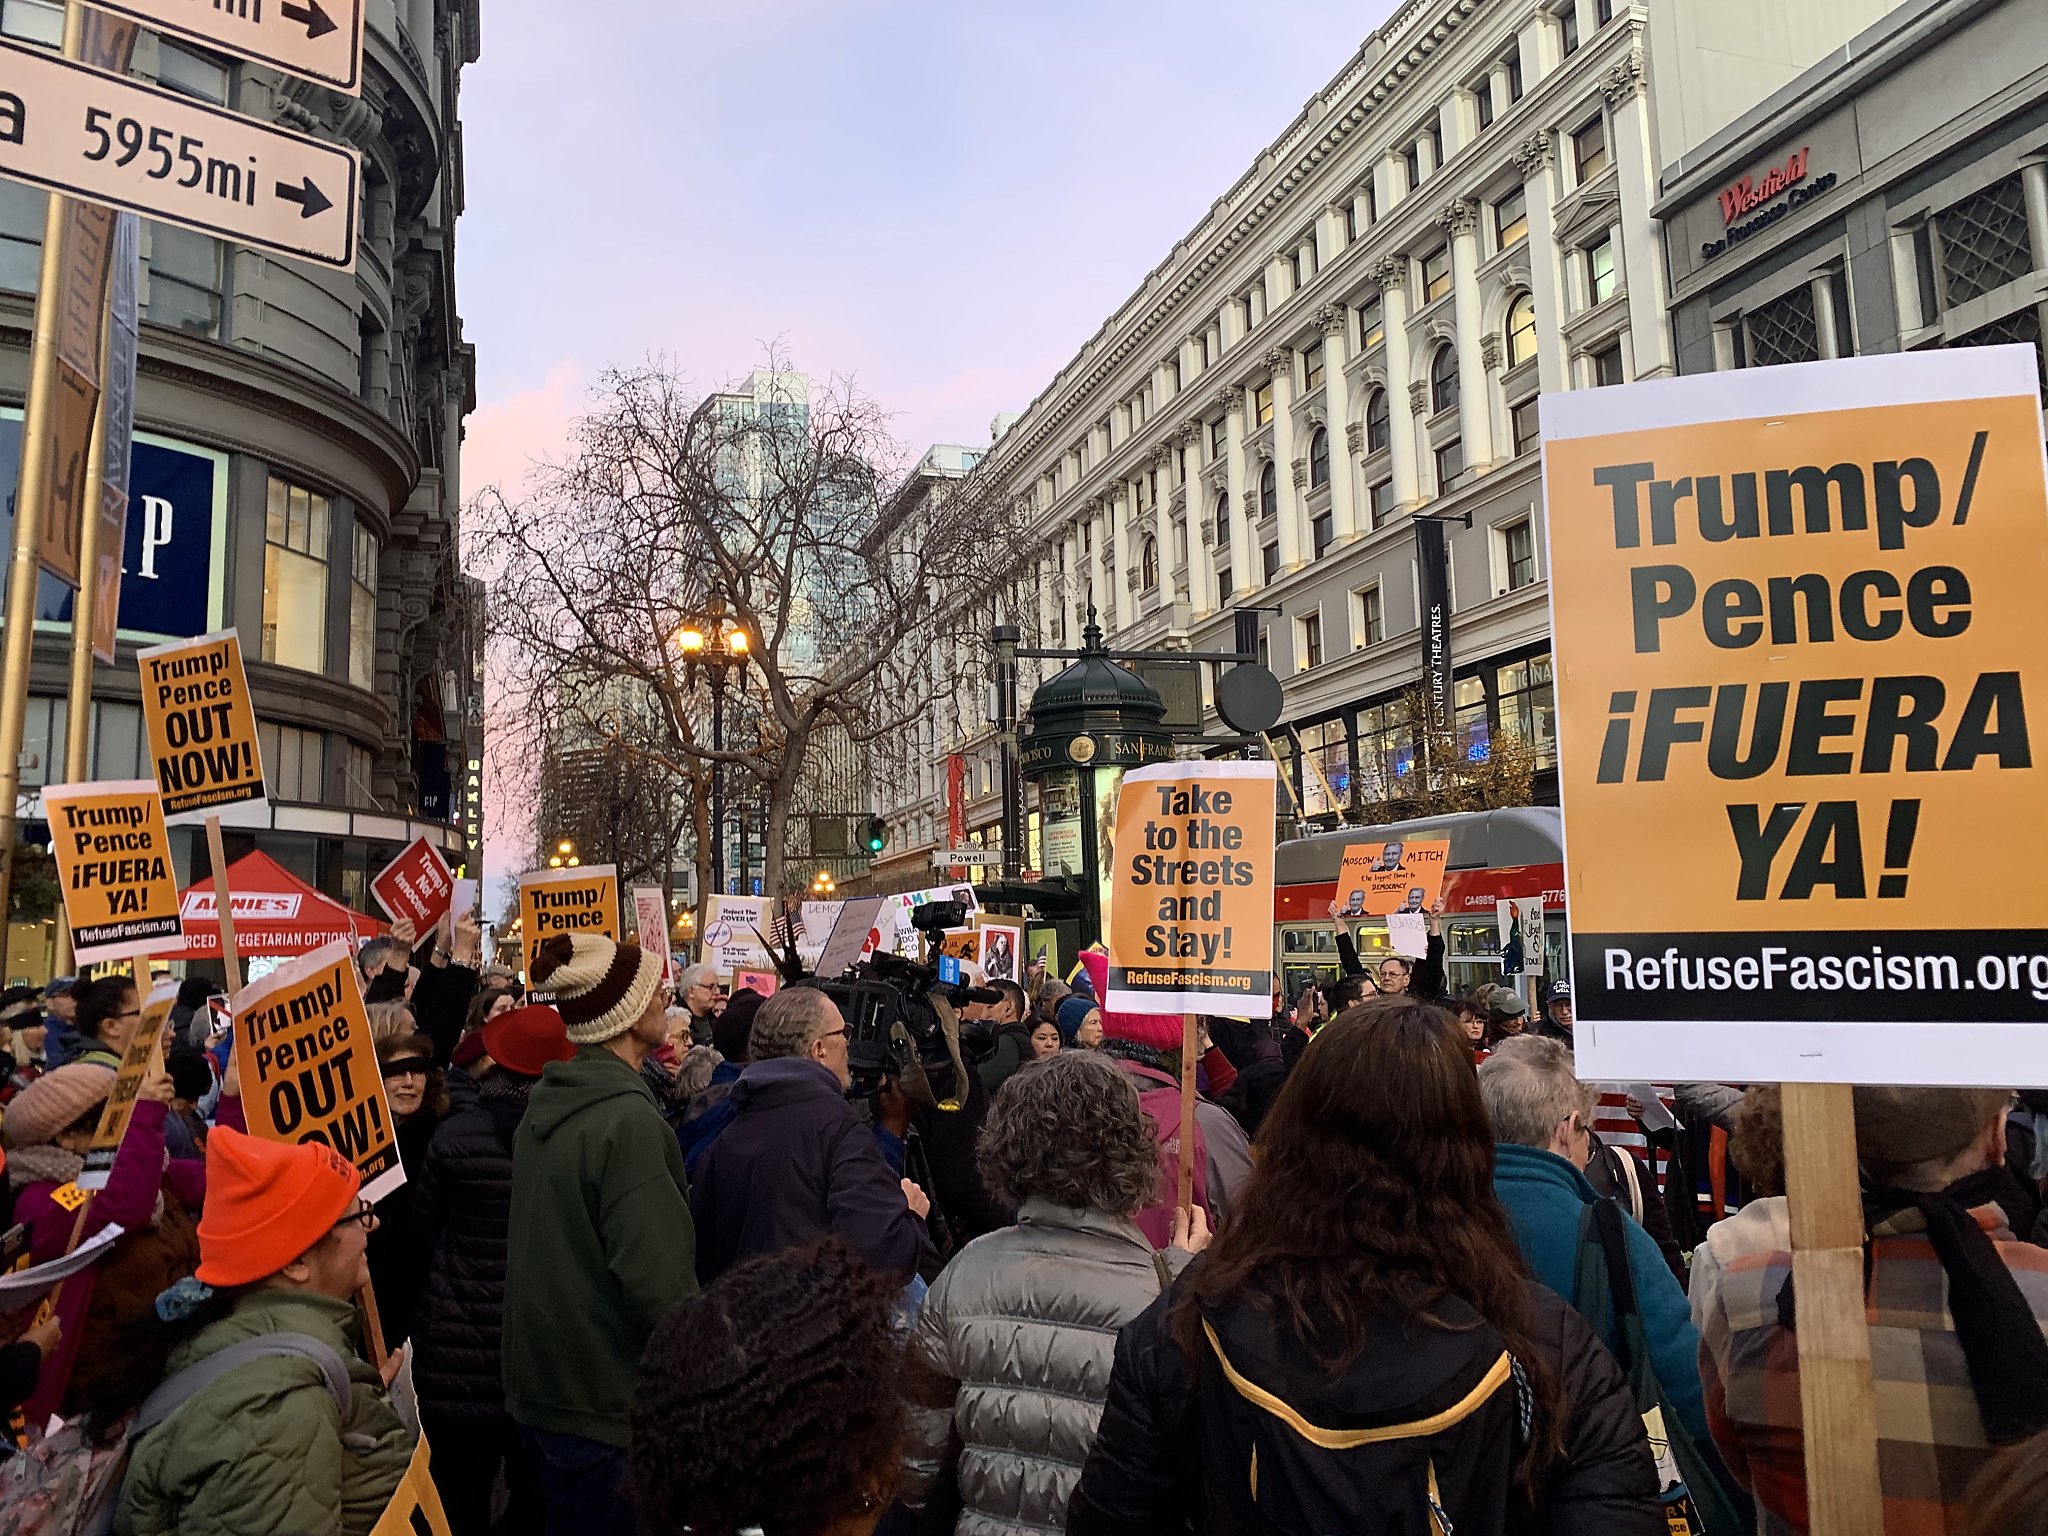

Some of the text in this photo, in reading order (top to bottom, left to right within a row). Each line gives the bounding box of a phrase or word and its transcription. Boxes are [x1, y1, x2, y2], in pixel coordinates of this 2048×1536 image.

[83, 106, 257, 207] 5955mi
[1718, 147, 1810, 225] Westfield
[1593, 431, 1989, 550] Trump/
[1630, 564, 1972, 653] Pence
[150, 643, 229, 683] Trump/
[158, 677, 232, 709] Pence
[165, 702, 233, 749] OUT
[1115, 742, 1138, 755] SAN
[158, 741, 254, 794] NOW!
[170, 786, 252, 811] RefuseFascism.org
[1157, 784, 1232, 816] Take
[61, 801, 151, 829] Trump/
[74, 832, 152, 855] Pence
[1145, 819, 1243, 850] to the
[1726, 799, 1921, 900] YA!
[419, 851, 442, 889] Trump
[950, 853, 985, 863] Powell
[1131, 854, 1254, 886] Streets
[1342, 851, 1443, 866] MOSCOW MITCH
[106, 887, 148, 916] YA!
[394, 870, 431, 920] Innocent!
[416, 874, 433, 898] Not
[530, 882, 606, 909] Trump/
[892, 891, 934, 909] SAME
[1372, 883, 1406, 891] DEMOCRACY
[538, 910, 603, 931] Pence
[723, 908, 744, 916] Reject
[1158, 890, 1222, 922] and
[80, 919, 177, 943] RefuseFascism.org
[901, 935, 914, 943] DO
[1145, 925, 1232, 965] Stay!
[1127, 970, 1251, 990] RefuseFascism.org
[1604, 946, 2048, 1000] RefuseFascism.org
[245, 967, 342, 1047] Trump/
[255, 1016, 350, 1083] Pence
[269, 1047, 354, 1135] OUT
